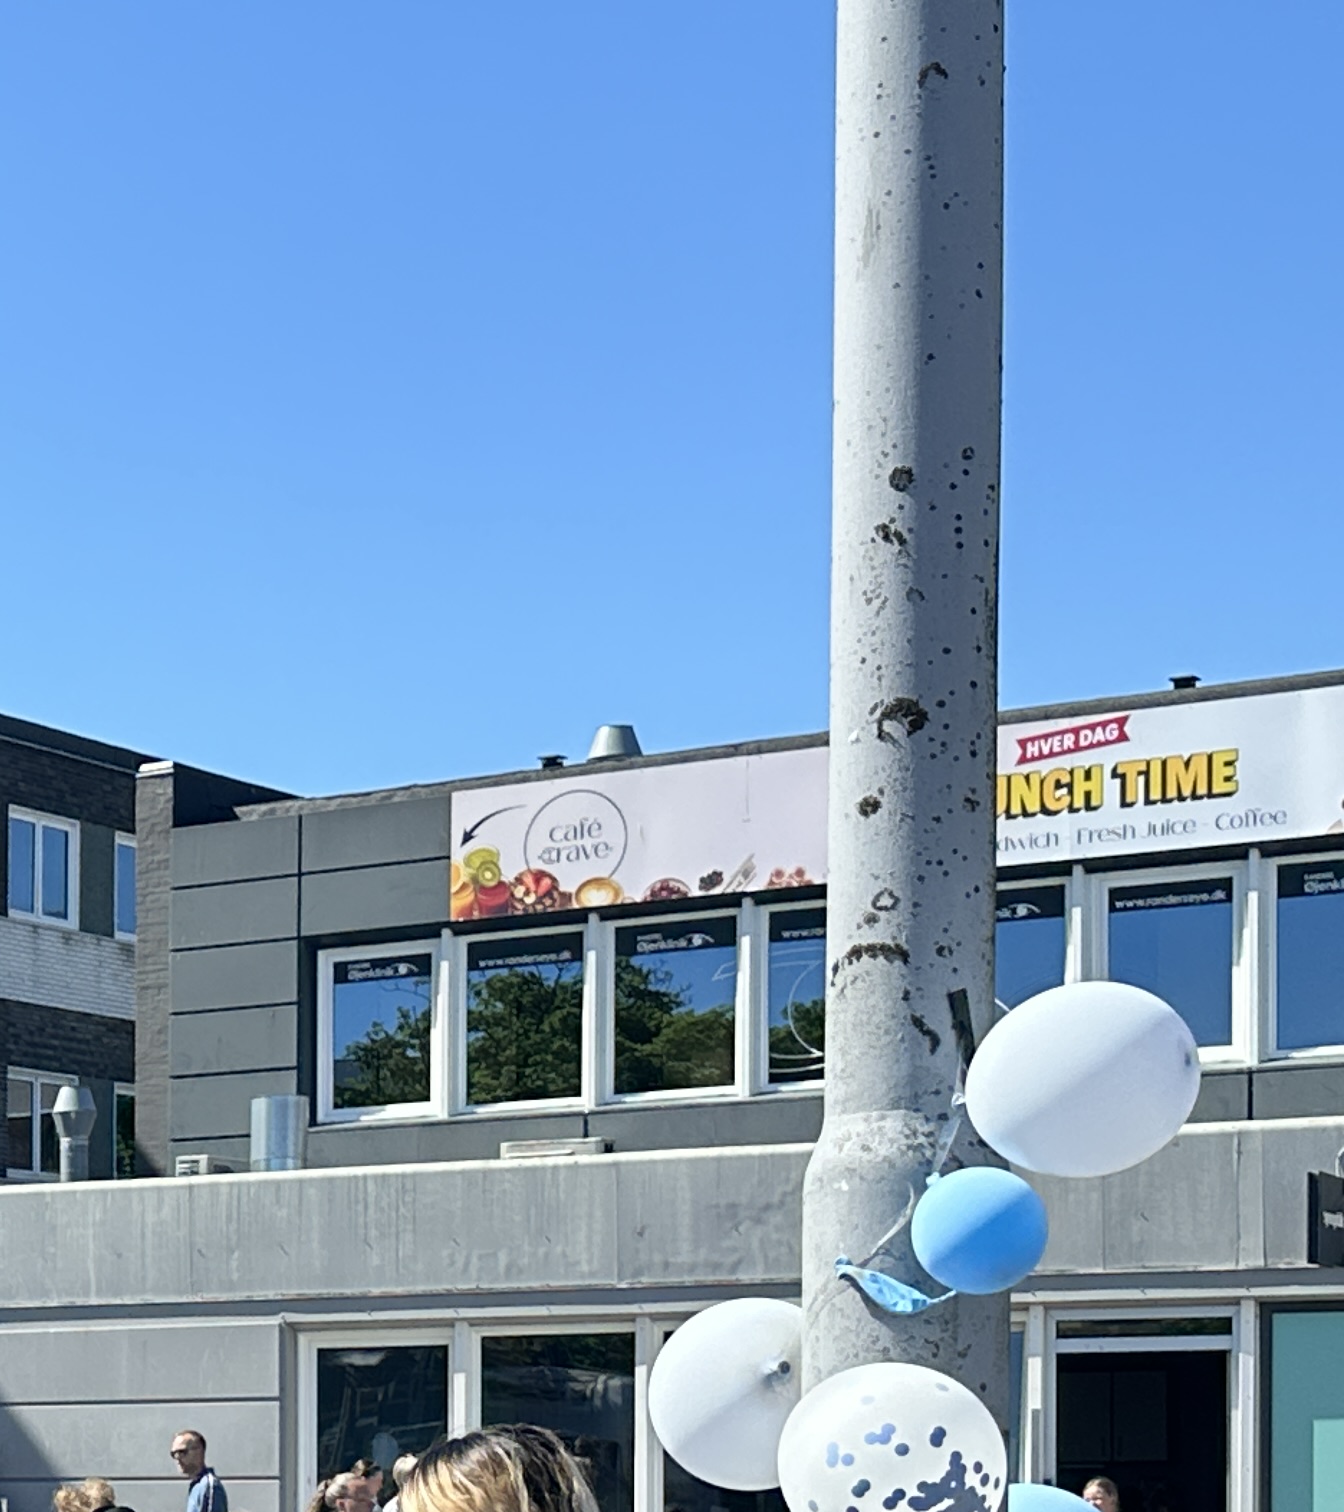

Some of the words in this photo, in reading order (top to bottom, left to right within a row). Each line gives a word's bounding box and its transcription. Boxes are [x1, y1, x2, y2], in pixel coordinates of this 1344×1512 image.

[1026, 731, 1075, 759] HVER
[1078, 722, 1120, 748] DAG
[1111, 748, 1239, 808] TIME
[997, 831, 1059, 853] dwich
[1076, 822, 1136, 846] Fresh
[1141, 817, 1197, 840] Juice
[1215, 807, 1288, 832] Coffee
